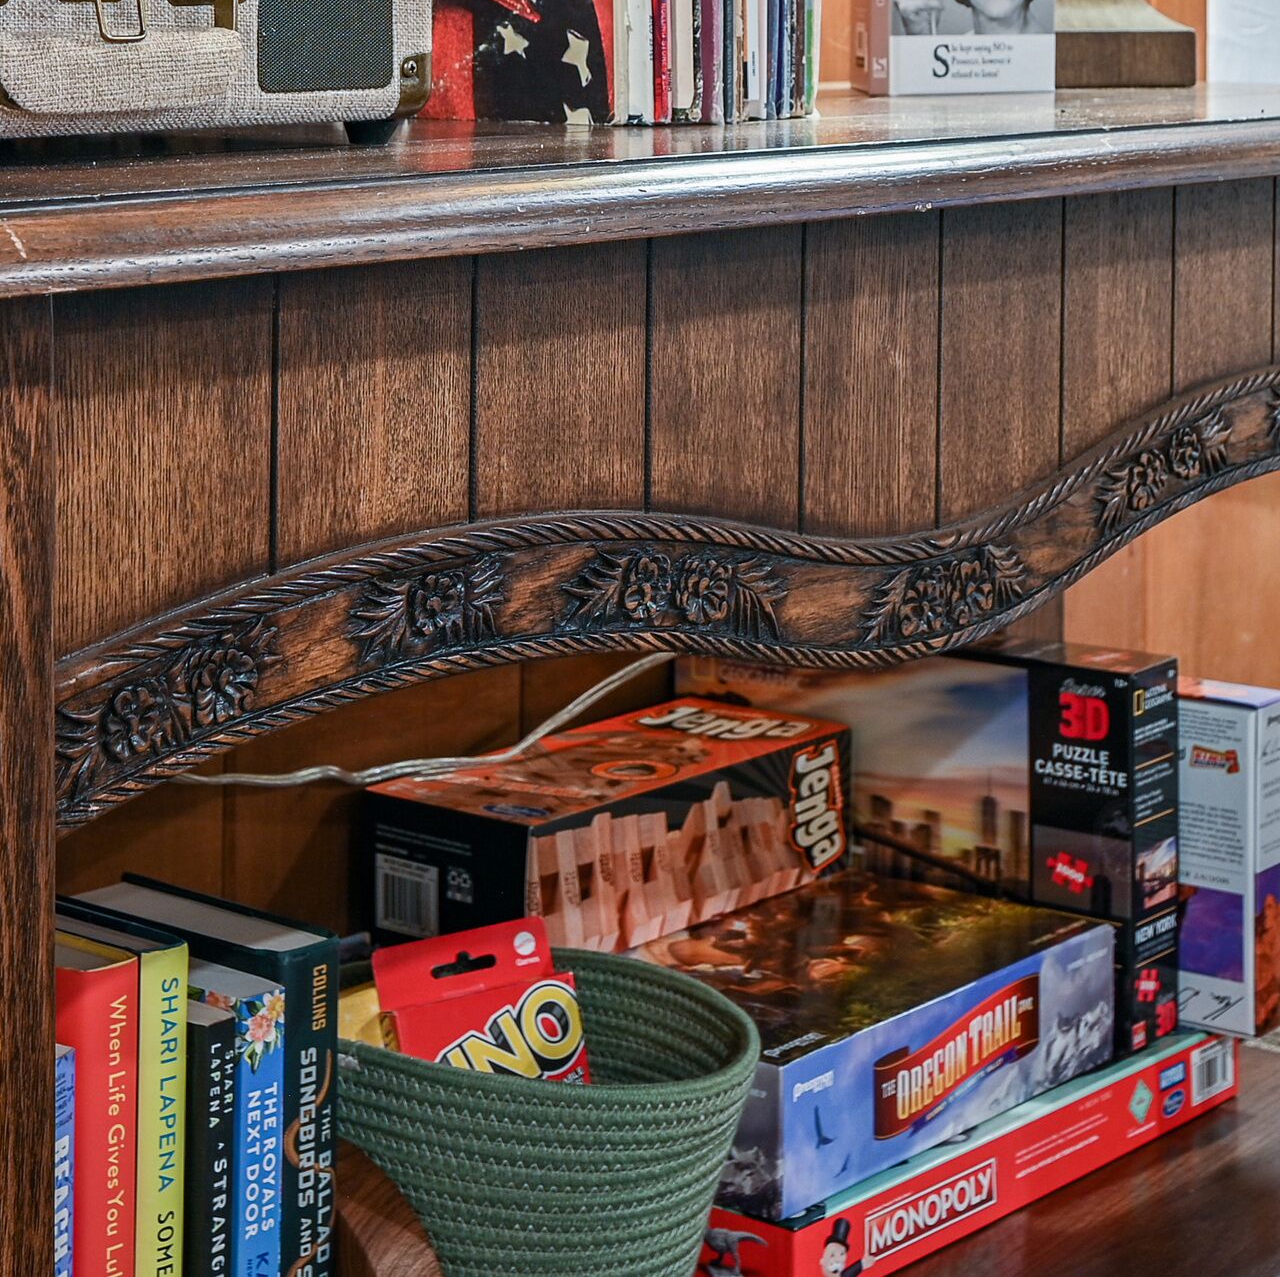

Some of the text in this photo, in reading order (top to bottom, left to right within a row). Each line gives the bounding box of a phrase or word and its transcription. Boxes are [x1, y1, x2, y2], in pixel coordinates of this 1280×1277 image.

[638, 706, 811, 740] Jenga
[1058, 690, 1111, 742] 3D
[1034, 758, 1128, 788] CASSE-TÊTE
[1051, 742, 1110, 765] PUZZLE
[794, 745, 842, 867] Jenga
[1134, 911, 1178, 945] NEW YORK
[109, 994, 127, 1067] When
[160, 977, 179, 1065] SHARI
[311, 963, 328, 1031] COLLINS
[108, 1070, 126, 1117] Life
[208, 1042, 222, 1130] LAPENA
[223, 1049, 235, 1114] SHARI
[881, 1077, 897, 1100] THE
[895, 1031, 969, 1120] OREGON
[968, 994, 1022, 1068] TRAIL
[107, 1123, 126, 1190] Gives
[157, 1075, 177, 1193] LAPENA
[260, 1081, 278, 1232] THE ROYALS
[297, 1046, 317, 1209] SONGBIRDS
[244, 1090, 261, 1241] NEXT DOOR
[316, 1104, 332, 1265] THE BALLAD
[106, 1189, 125, 1237] You
[210, 1158, 228, 1277] STRANG
[299, 1217, 312, 1258] AND
[870, 1167, 993, 1255] MONOPOLY
